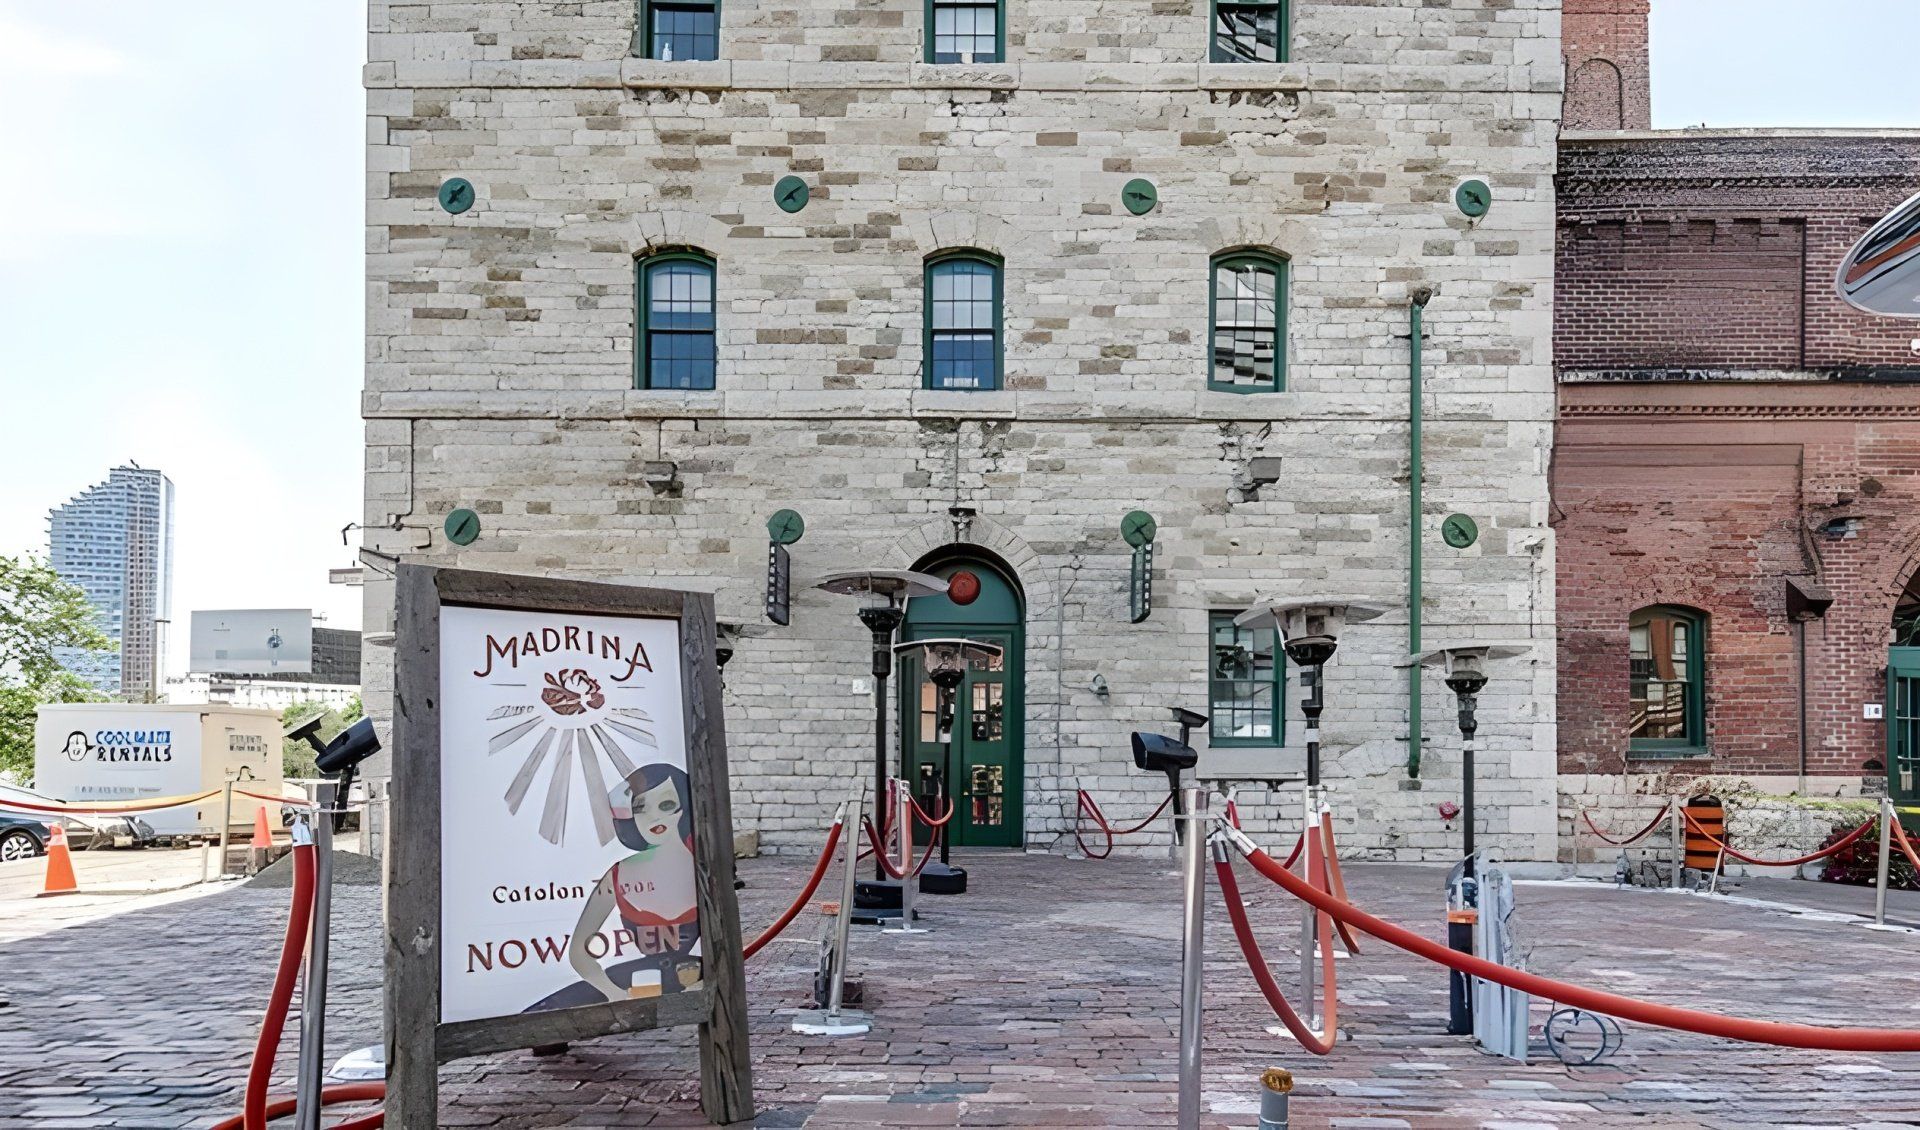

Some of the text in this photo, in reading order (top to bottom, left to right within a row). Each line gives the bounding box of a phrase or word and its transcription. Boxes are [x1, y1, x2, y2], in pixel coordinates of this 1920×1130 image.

[474, 626, 653, 682] MADRINA
[466, 925, 679, 973] NOW OPEN
